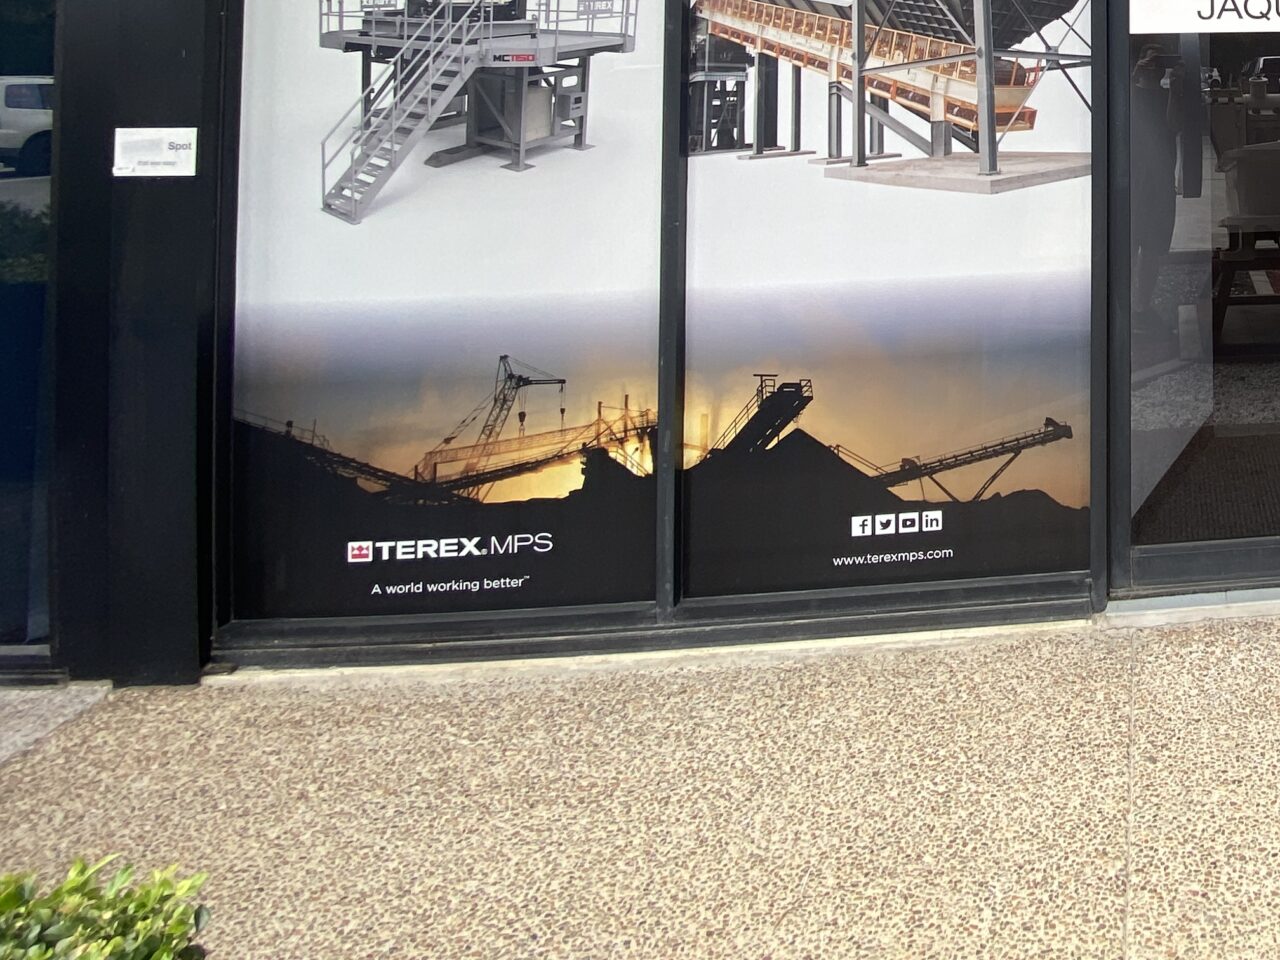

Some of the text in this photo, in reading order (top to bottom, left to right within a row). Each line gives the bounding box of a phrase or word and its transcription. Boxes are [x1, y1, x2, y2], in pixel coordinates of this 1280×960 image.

[168, 141, 192, 152] Spot
[832, 548, 954, 566] www.terexmps.com
[371, 584, 382, 595] A
[386, 582, 423, 594] world
[427, 579, 480, 592] working
